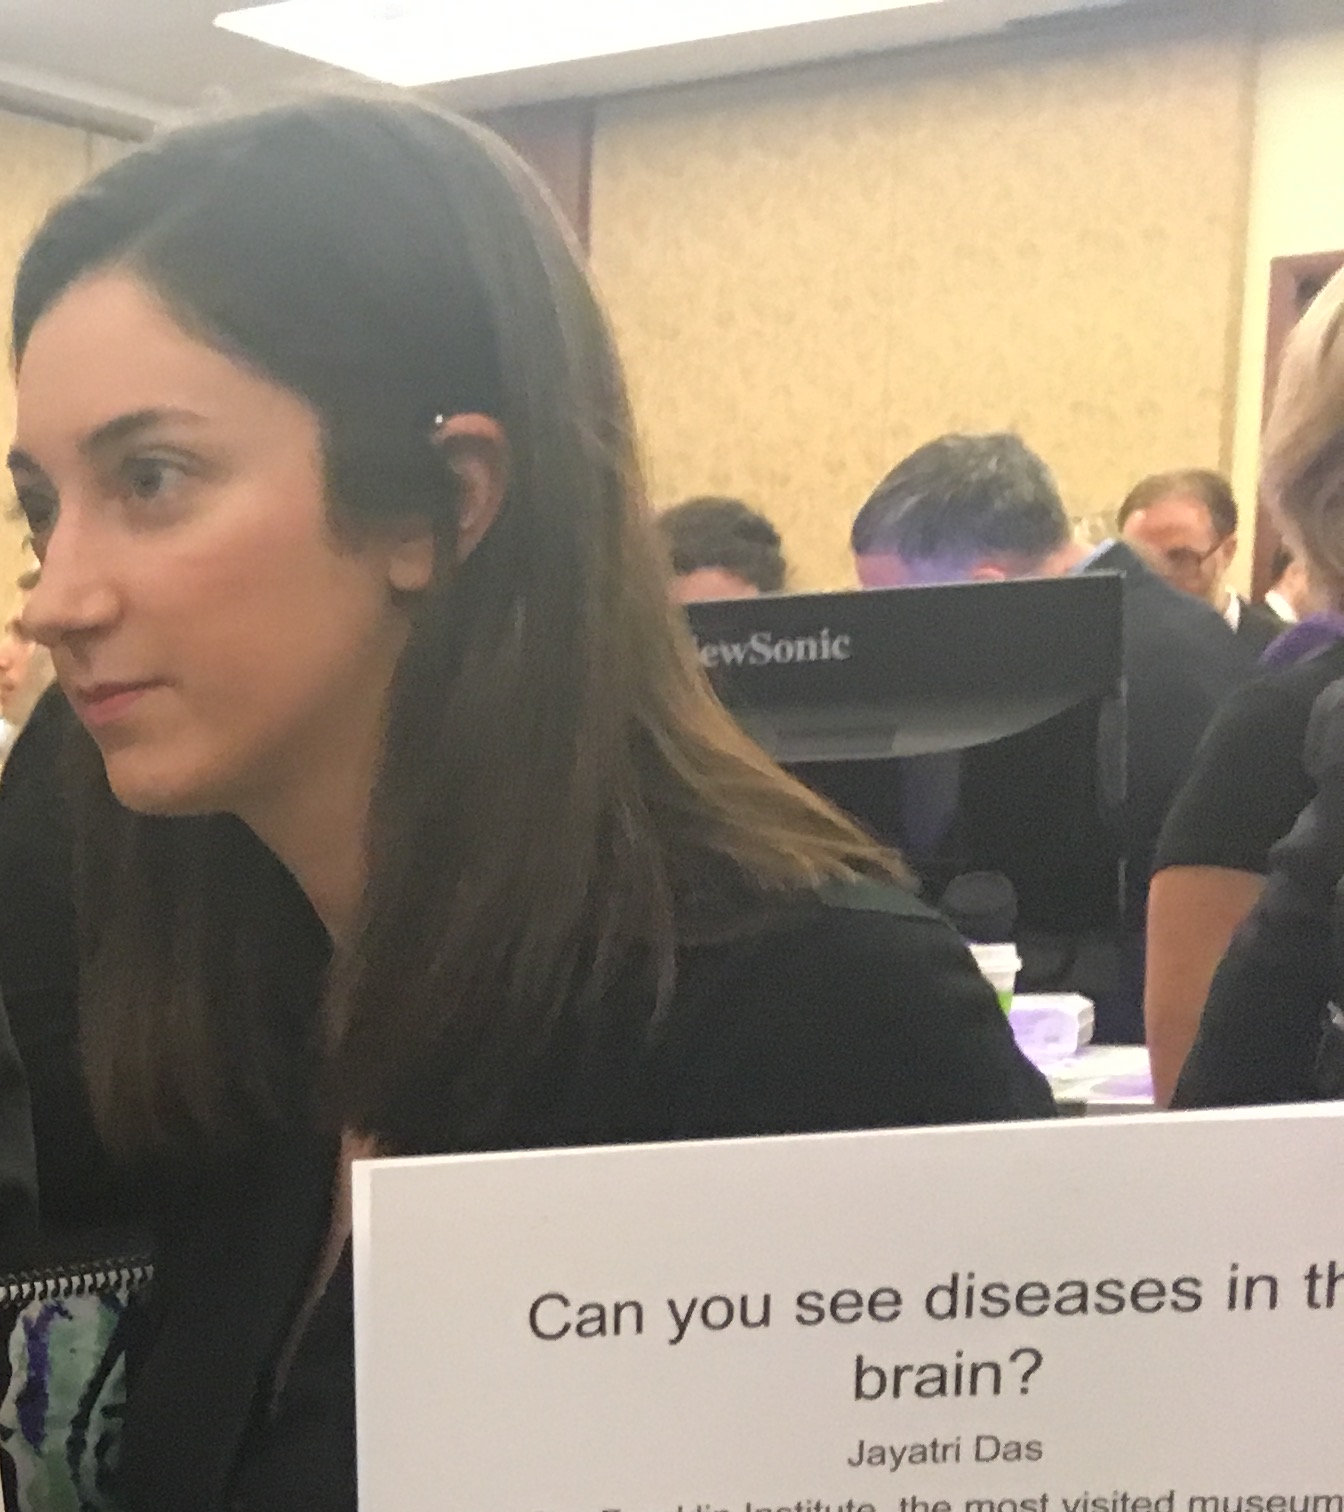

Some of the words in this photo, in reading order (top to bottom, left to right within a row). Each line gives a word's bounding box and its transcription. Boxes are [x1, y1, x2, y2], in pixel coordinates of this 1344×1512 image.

[528, 1291, 644, 1341] Can
[666, 1292, 772, 1347] you
[795, 1286, 904, 1326] see
[924, 1271, 1203, 1321] diseases
[1227, 1262, 1279, 1312] in
[853, 1346, 1044, 1402] brain?
[847, 1435, 962, 1473] Jayatri
[974, 1434, 1044, 1463] Das
